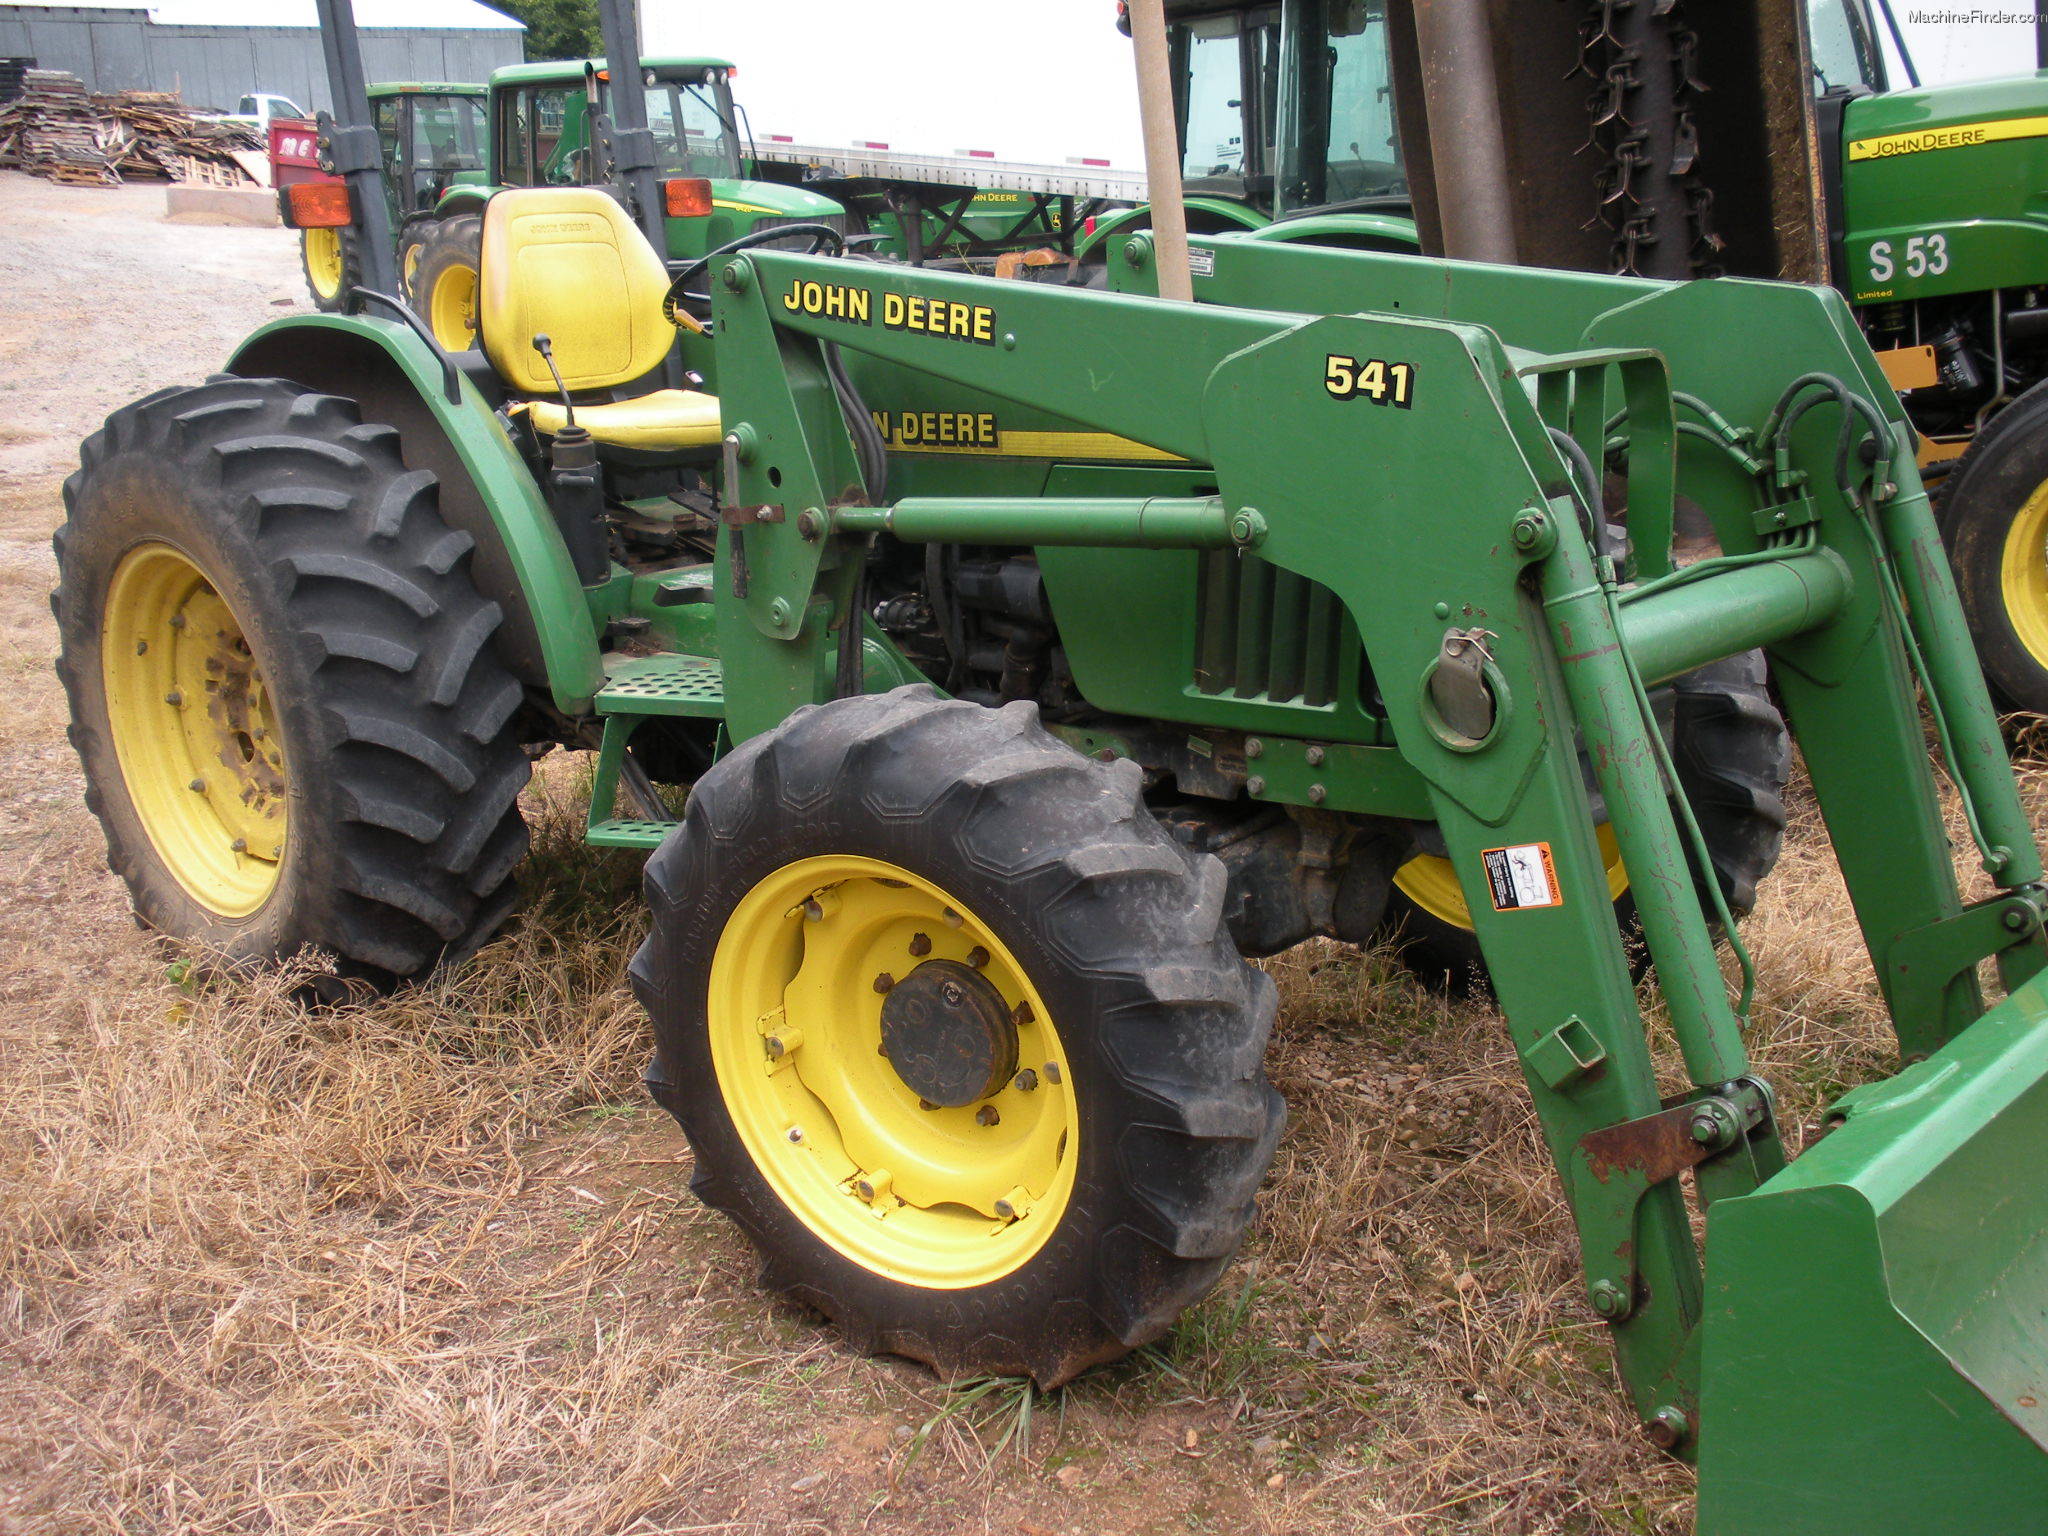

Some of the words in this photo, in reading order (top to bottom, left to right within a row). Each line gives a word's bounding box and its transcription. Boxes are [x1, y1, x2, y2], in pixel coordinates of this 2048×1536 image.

[1872, 139, 1919, 156] JOHN
[1923, 129, 1985, 149] DEERE
[988, 192, 1018, 202] DEERE
[1869, 241, 1894, 282] S
[1906, 233, 1949, 278] 53
[784, 278, 872, 326] JOHN
[883, 291, 995, 346] DEERE
[1857, 290, 1893, 299] Limited
[1325, 354, 1413, 409] 541
[901, 411, 998, 447] DEERE
[1544, 861, 1559, 899] WARNING
